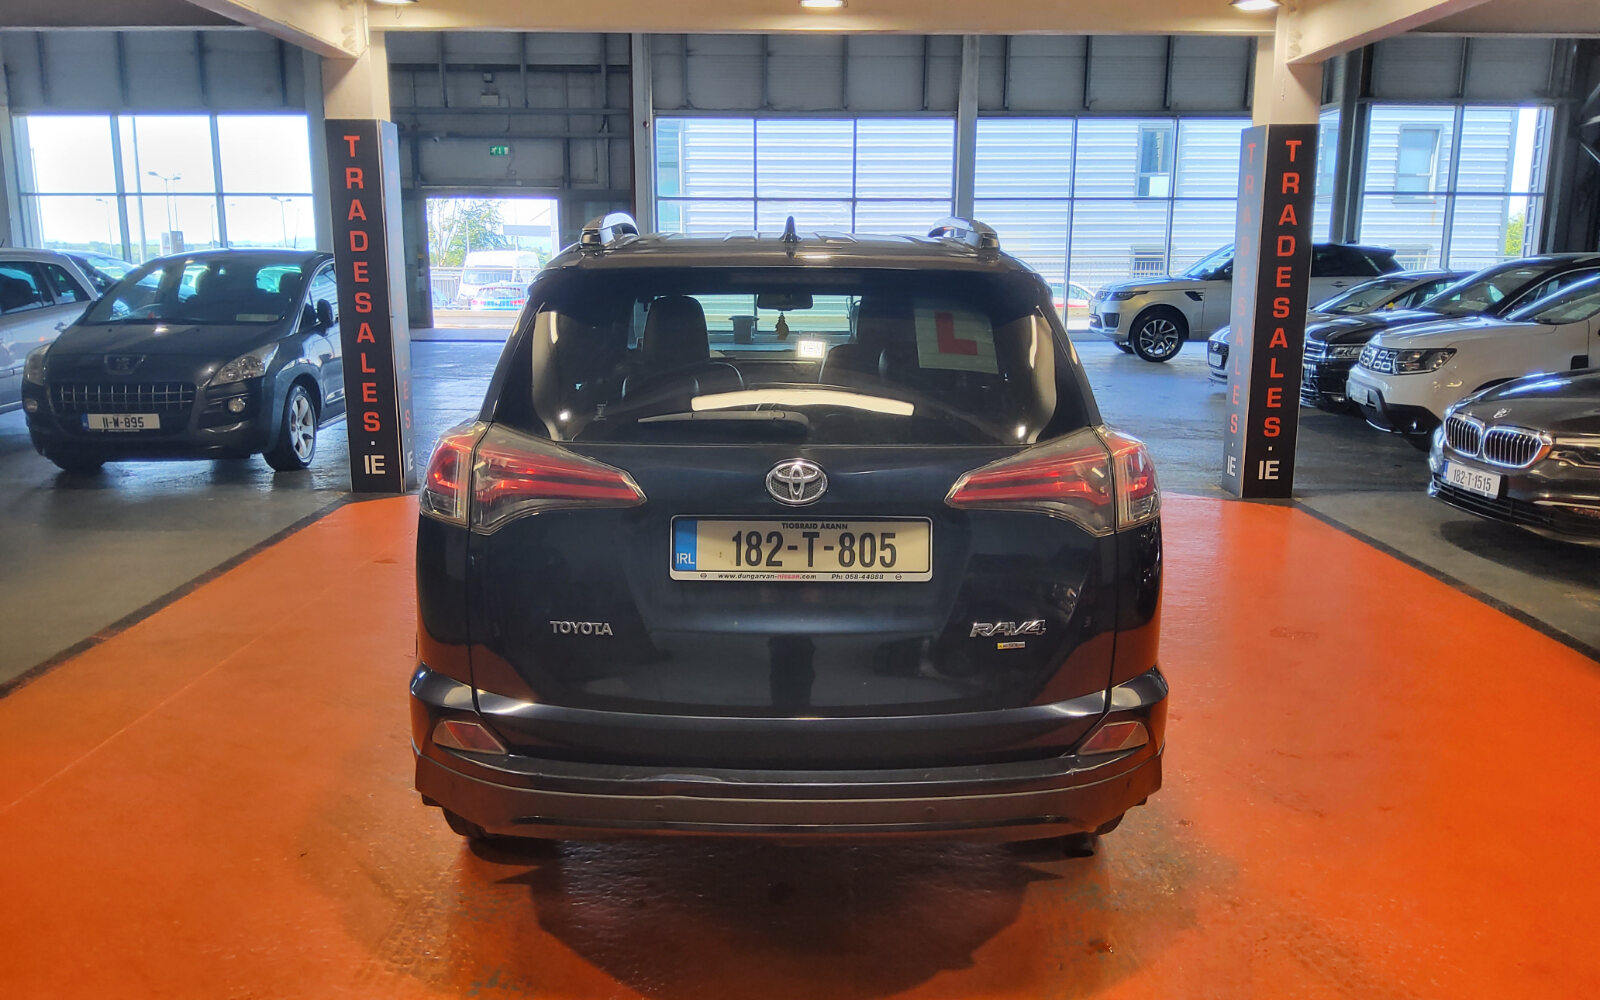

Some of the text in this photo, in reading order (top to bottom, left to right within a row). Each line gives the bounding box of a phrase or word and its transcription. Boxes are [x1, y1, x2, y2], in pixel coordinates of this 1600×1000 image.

[933, 311, 978, 356] L
[102, 416, 144, 428] 11-W-895
[1453, 468, 1492, 492] 182-T-1515
[676, 552, 695, 564] IRL
[732, 530, 897, 568] 182-T-805
[550, 620, 613, 635] TOYOTA
[969, 619, 1046, 637] RAV4
